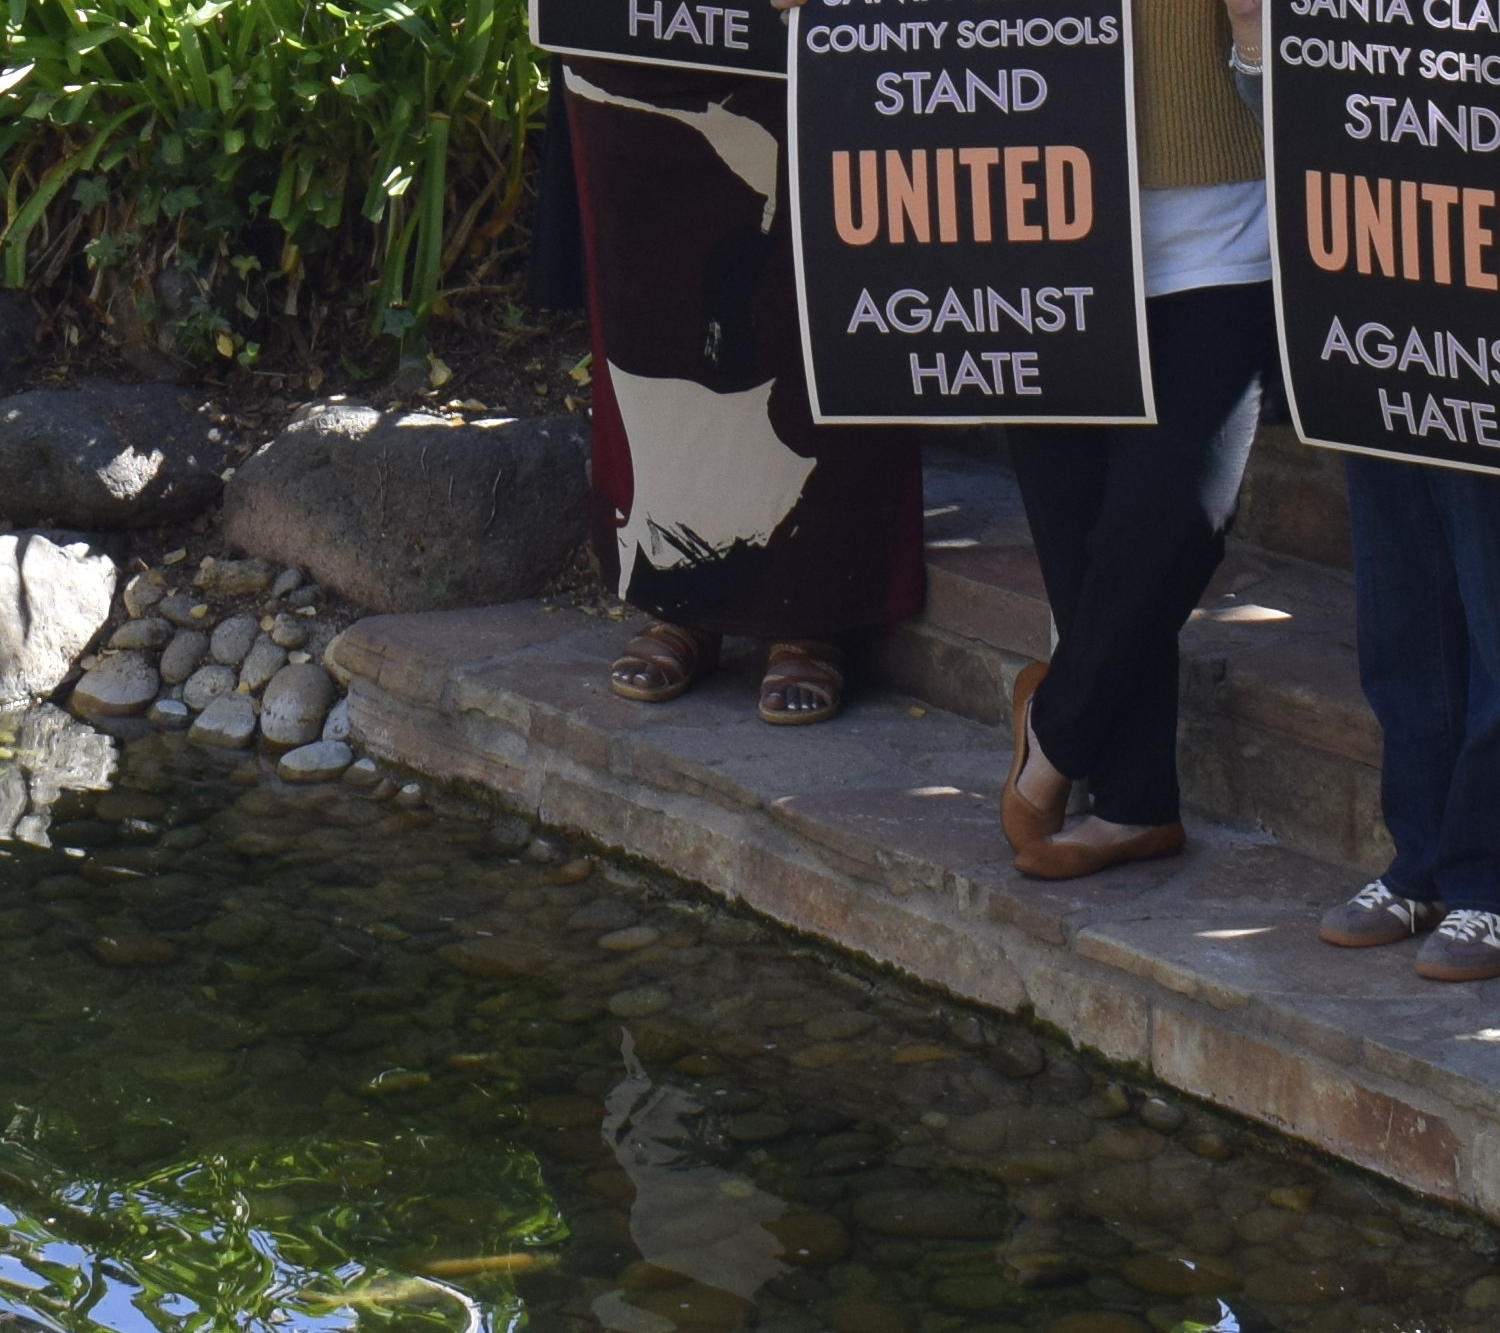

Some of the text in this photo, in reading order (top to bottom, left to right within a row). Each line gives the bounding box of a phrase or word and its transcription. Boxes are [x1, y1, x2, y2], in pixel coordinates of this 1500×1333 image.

[807, 16, 1118, 53] COUNTY SCHOOLS
[1280, 35, 1411, 76] COUNTY
[875, 68, 1048, 115] STAND
[832, 145, 1093, 245] UNITED
[847, 286, 1093, 334] AGAINST
[909, 350, 1042, 395] HATE
[1378, 387, 1500, 448] HATE
